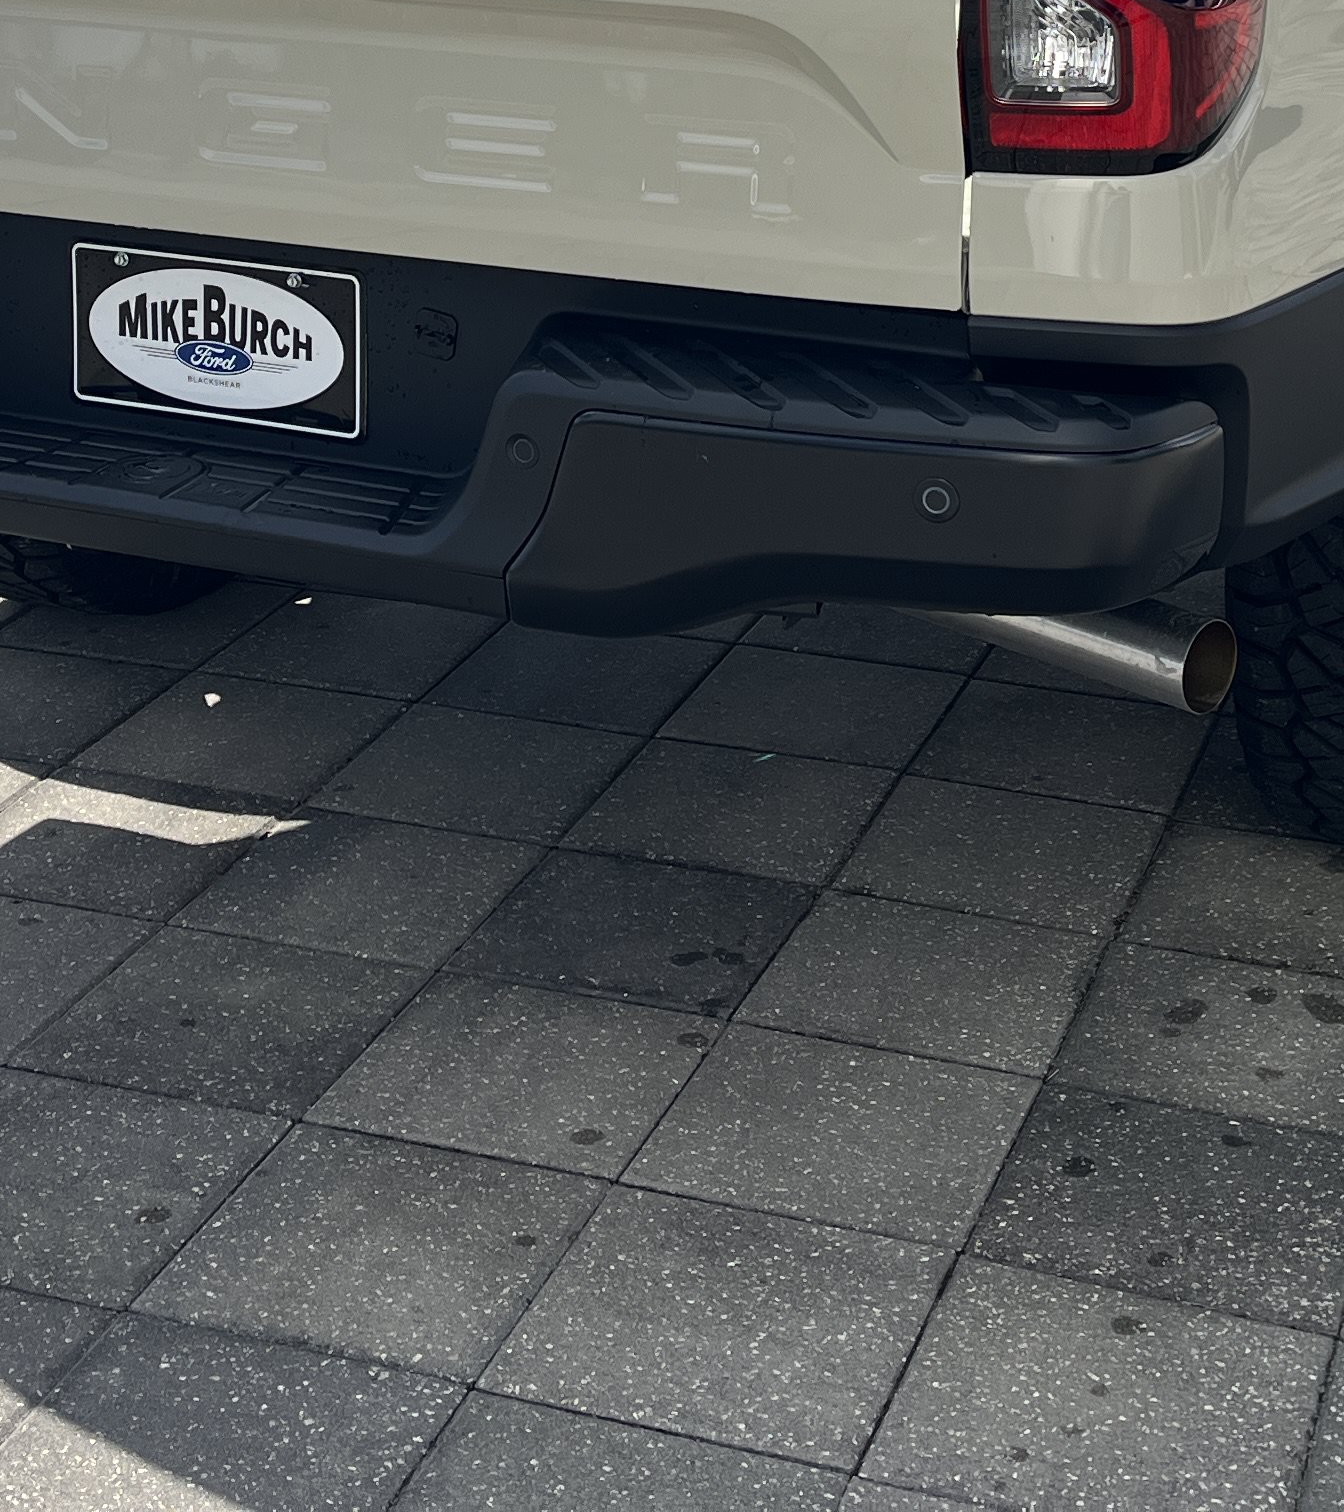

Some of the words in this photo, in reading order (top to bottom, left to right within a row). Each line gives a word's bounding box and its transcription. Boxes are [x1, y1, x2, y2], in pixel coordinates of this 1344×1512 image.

[118, 292, 199, 344] MIKE
[203, 284, 313, 362] BURCH
[190, 345, 237, 371] Ford
[187, 375, 241, 389] BLACKSHEAR
